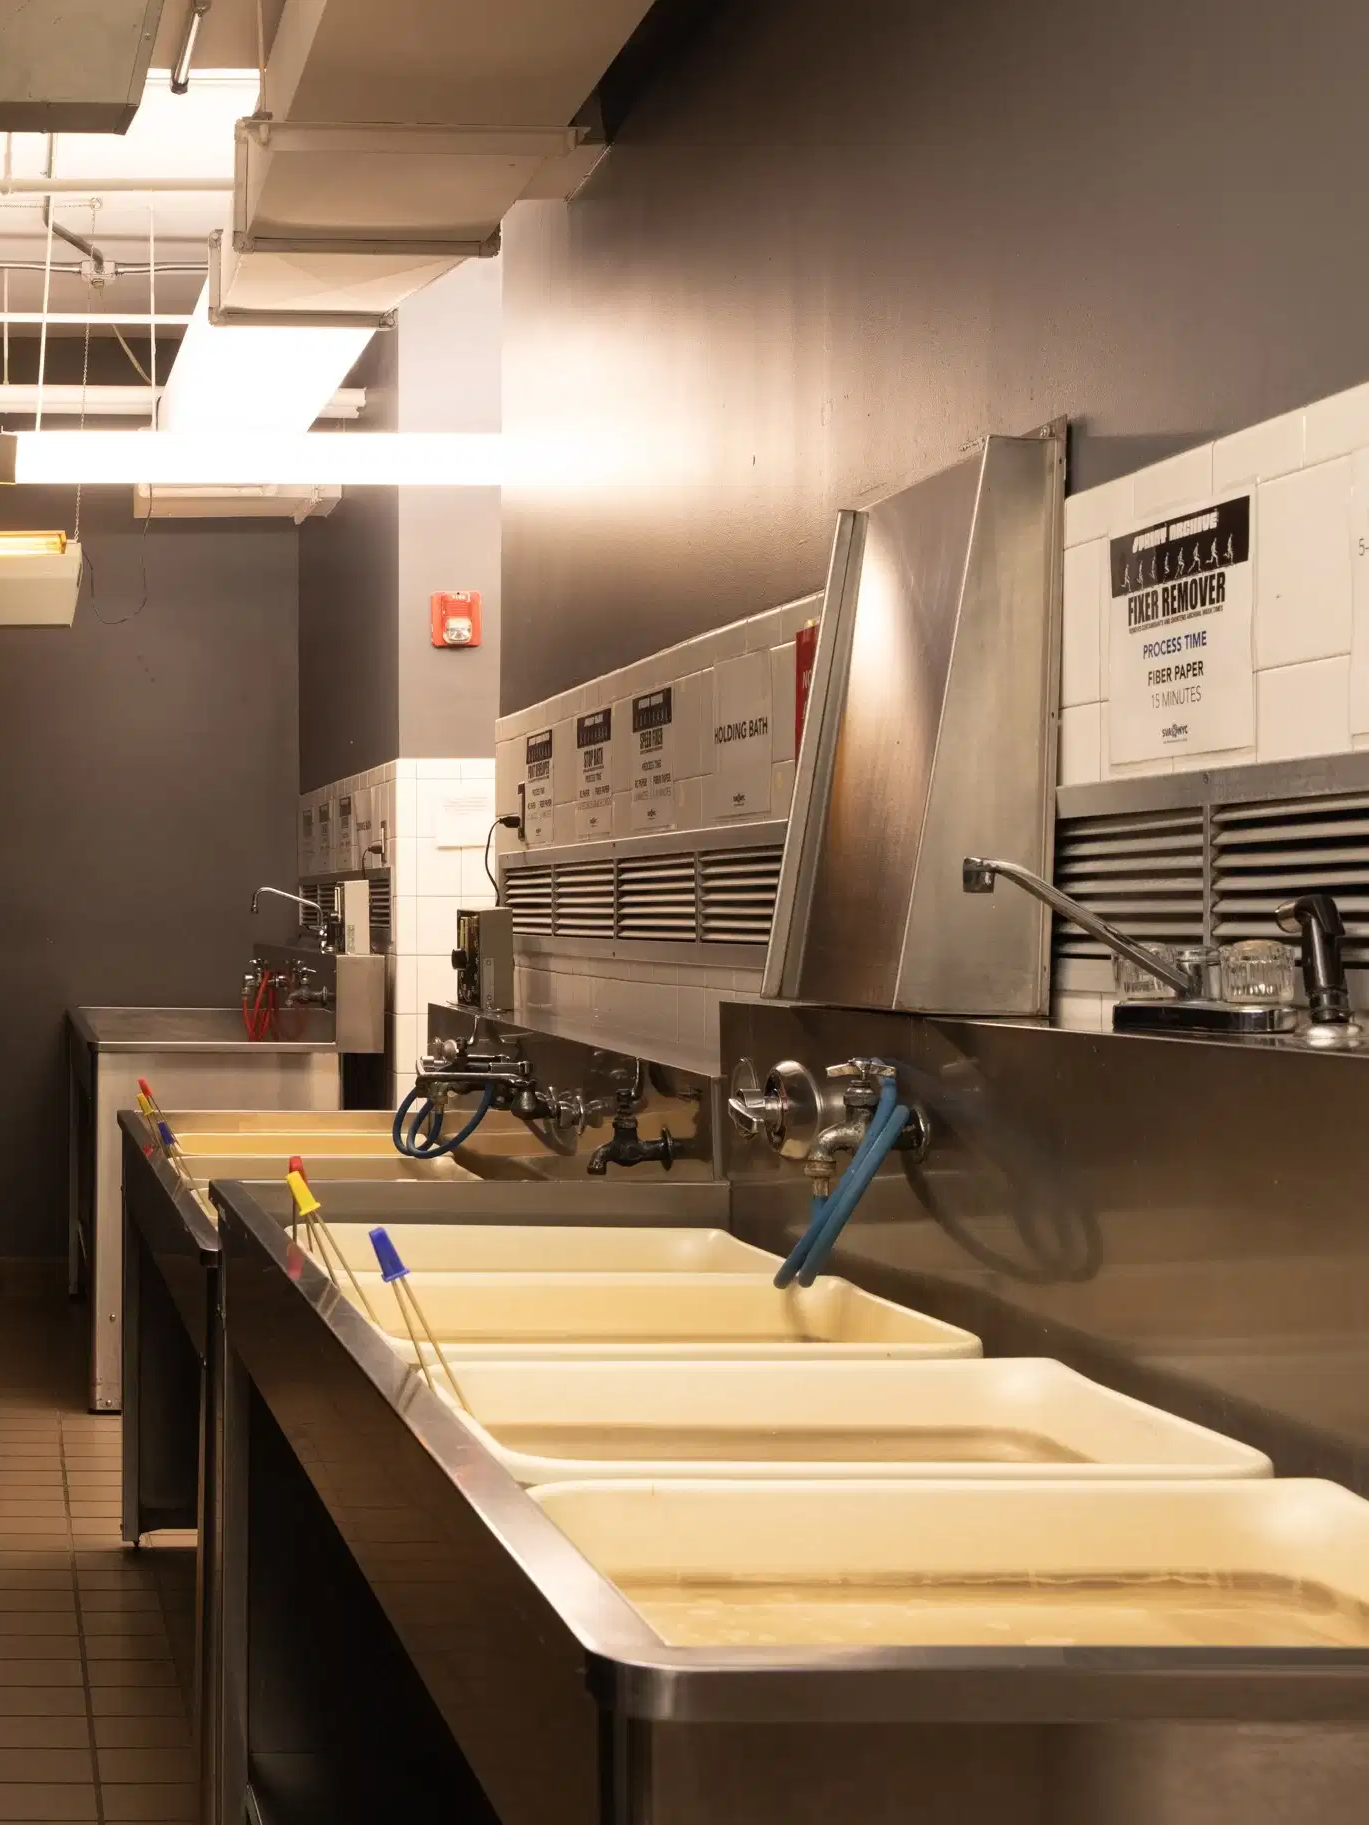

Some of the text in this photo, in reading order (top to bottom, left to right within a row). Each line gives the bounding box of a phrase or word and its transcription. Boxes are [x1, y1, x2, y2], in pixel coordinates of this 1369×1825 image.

[1128, 571, 1226, 627] FIXER REMOVER
[1143, 630, 1207, 660] PROCESS TIME
[1148, 660, 1204, 686] FIBER PAPER
[1152, 685, 1202, 709] 15 MINUTES
[714, 717, 768, 744] HOLDING BATH
